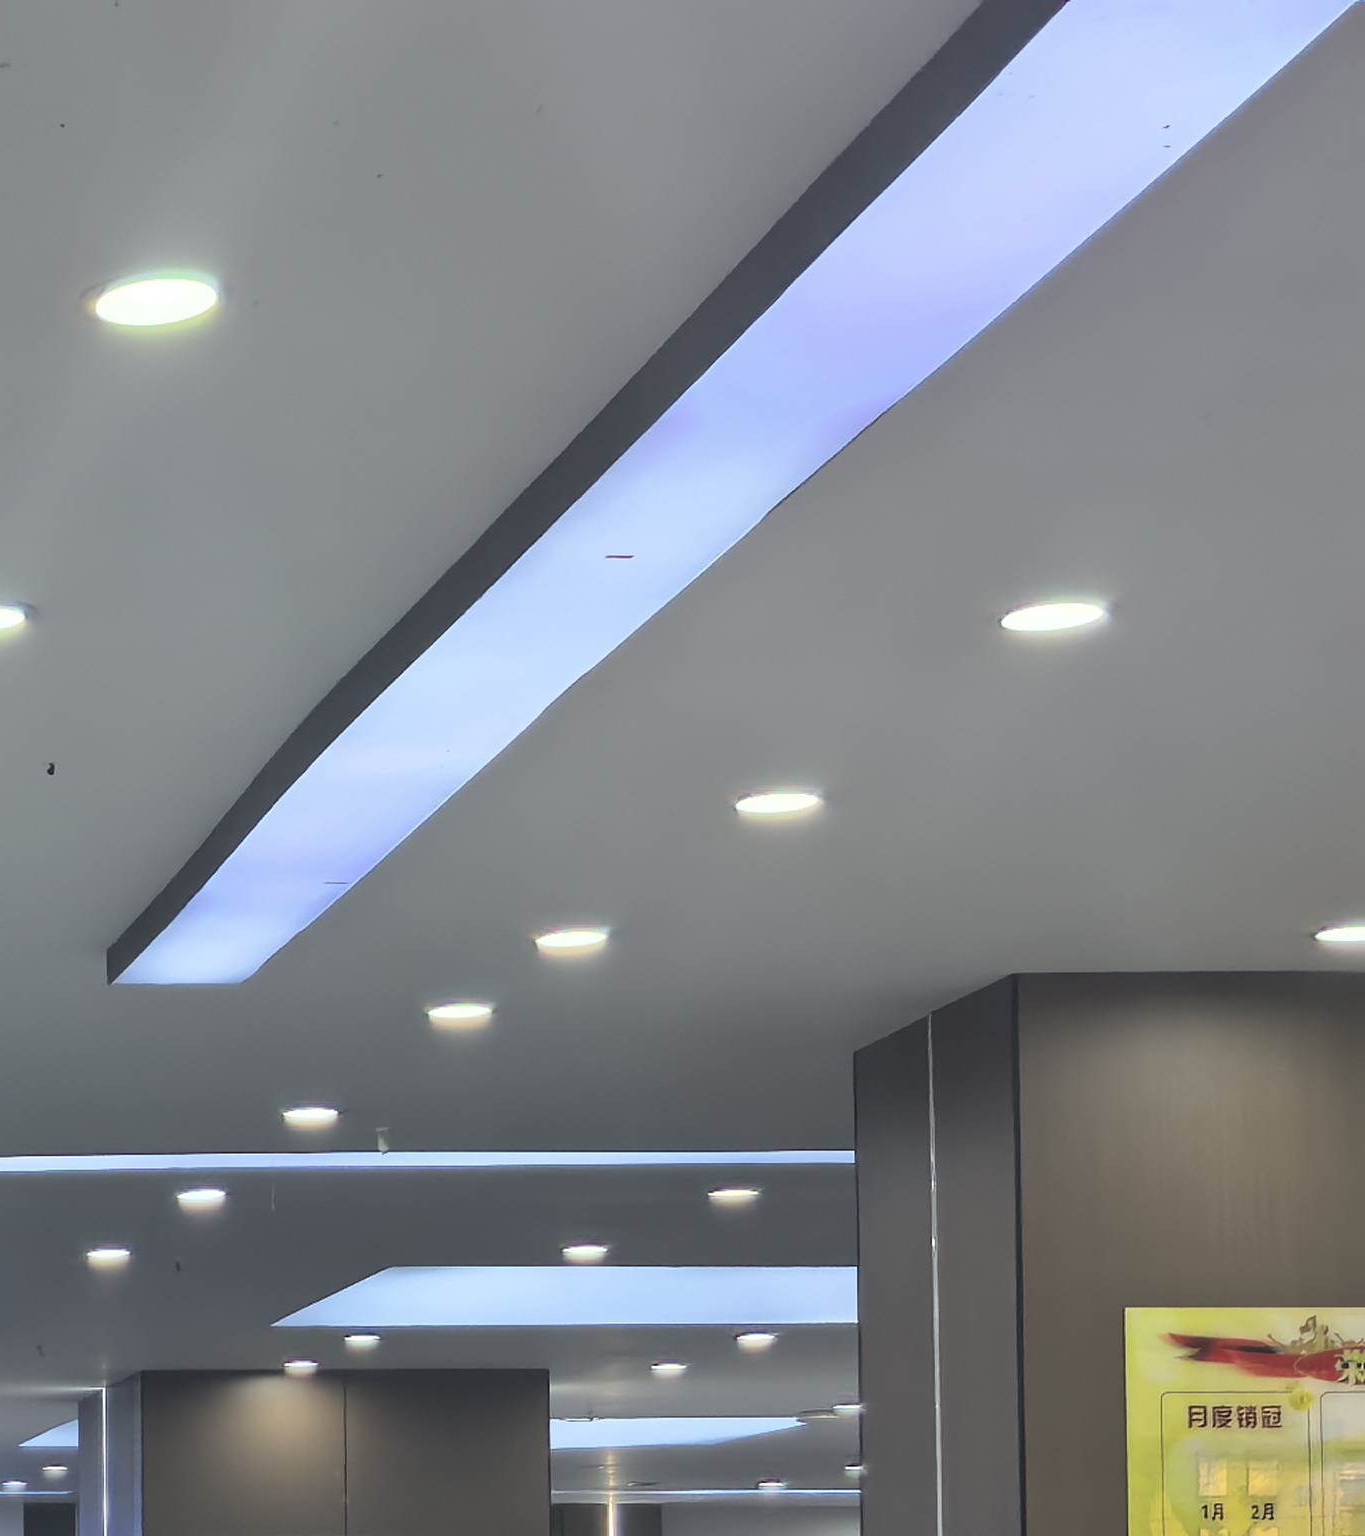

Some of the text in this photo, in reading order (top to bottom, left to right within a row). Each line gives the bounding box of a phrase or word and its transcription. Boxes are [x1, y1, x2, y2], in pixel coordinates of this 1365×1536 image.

[1187, 1404, 1283, 1429] 月度销冠
[1200, 1503, 1275, 1521] 1月 2月
